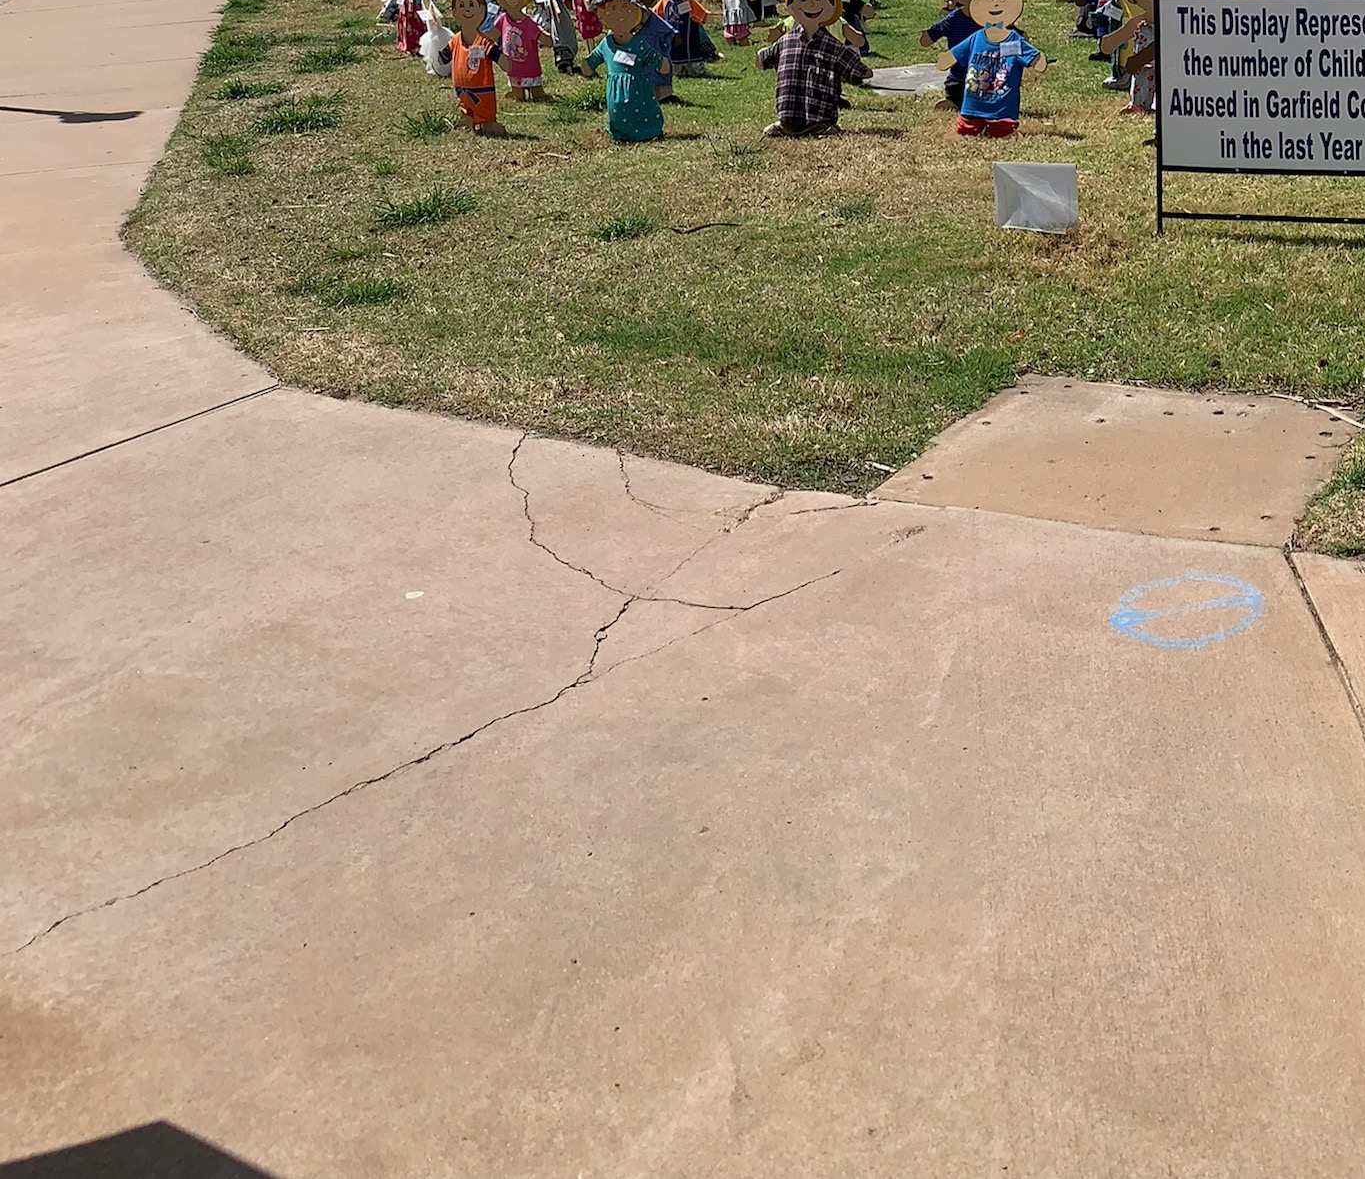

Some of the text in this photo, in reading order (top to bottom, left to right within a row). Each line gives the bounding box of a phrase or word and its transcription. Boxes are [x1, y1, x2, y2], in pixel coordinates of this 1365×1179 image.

[1177, 7, 1217, 35] This
[1221, 8, 1289, 42] Display
[1183, 49, 1214, 77] the
[1218, 50, 1290, 78] number
[1294, 49, 1314, 78] of
[1169, 89, 1238, 118] Abused
[1243, 90, 1261, 118] in
[1266, 90, 1340, 120] Garfield
[1220, 132, 1238, 158] in
[1242, 132, 1273, 159] the
[1278, 132, 1314, 160] last
[1321, 133, 1363, 161] Year
